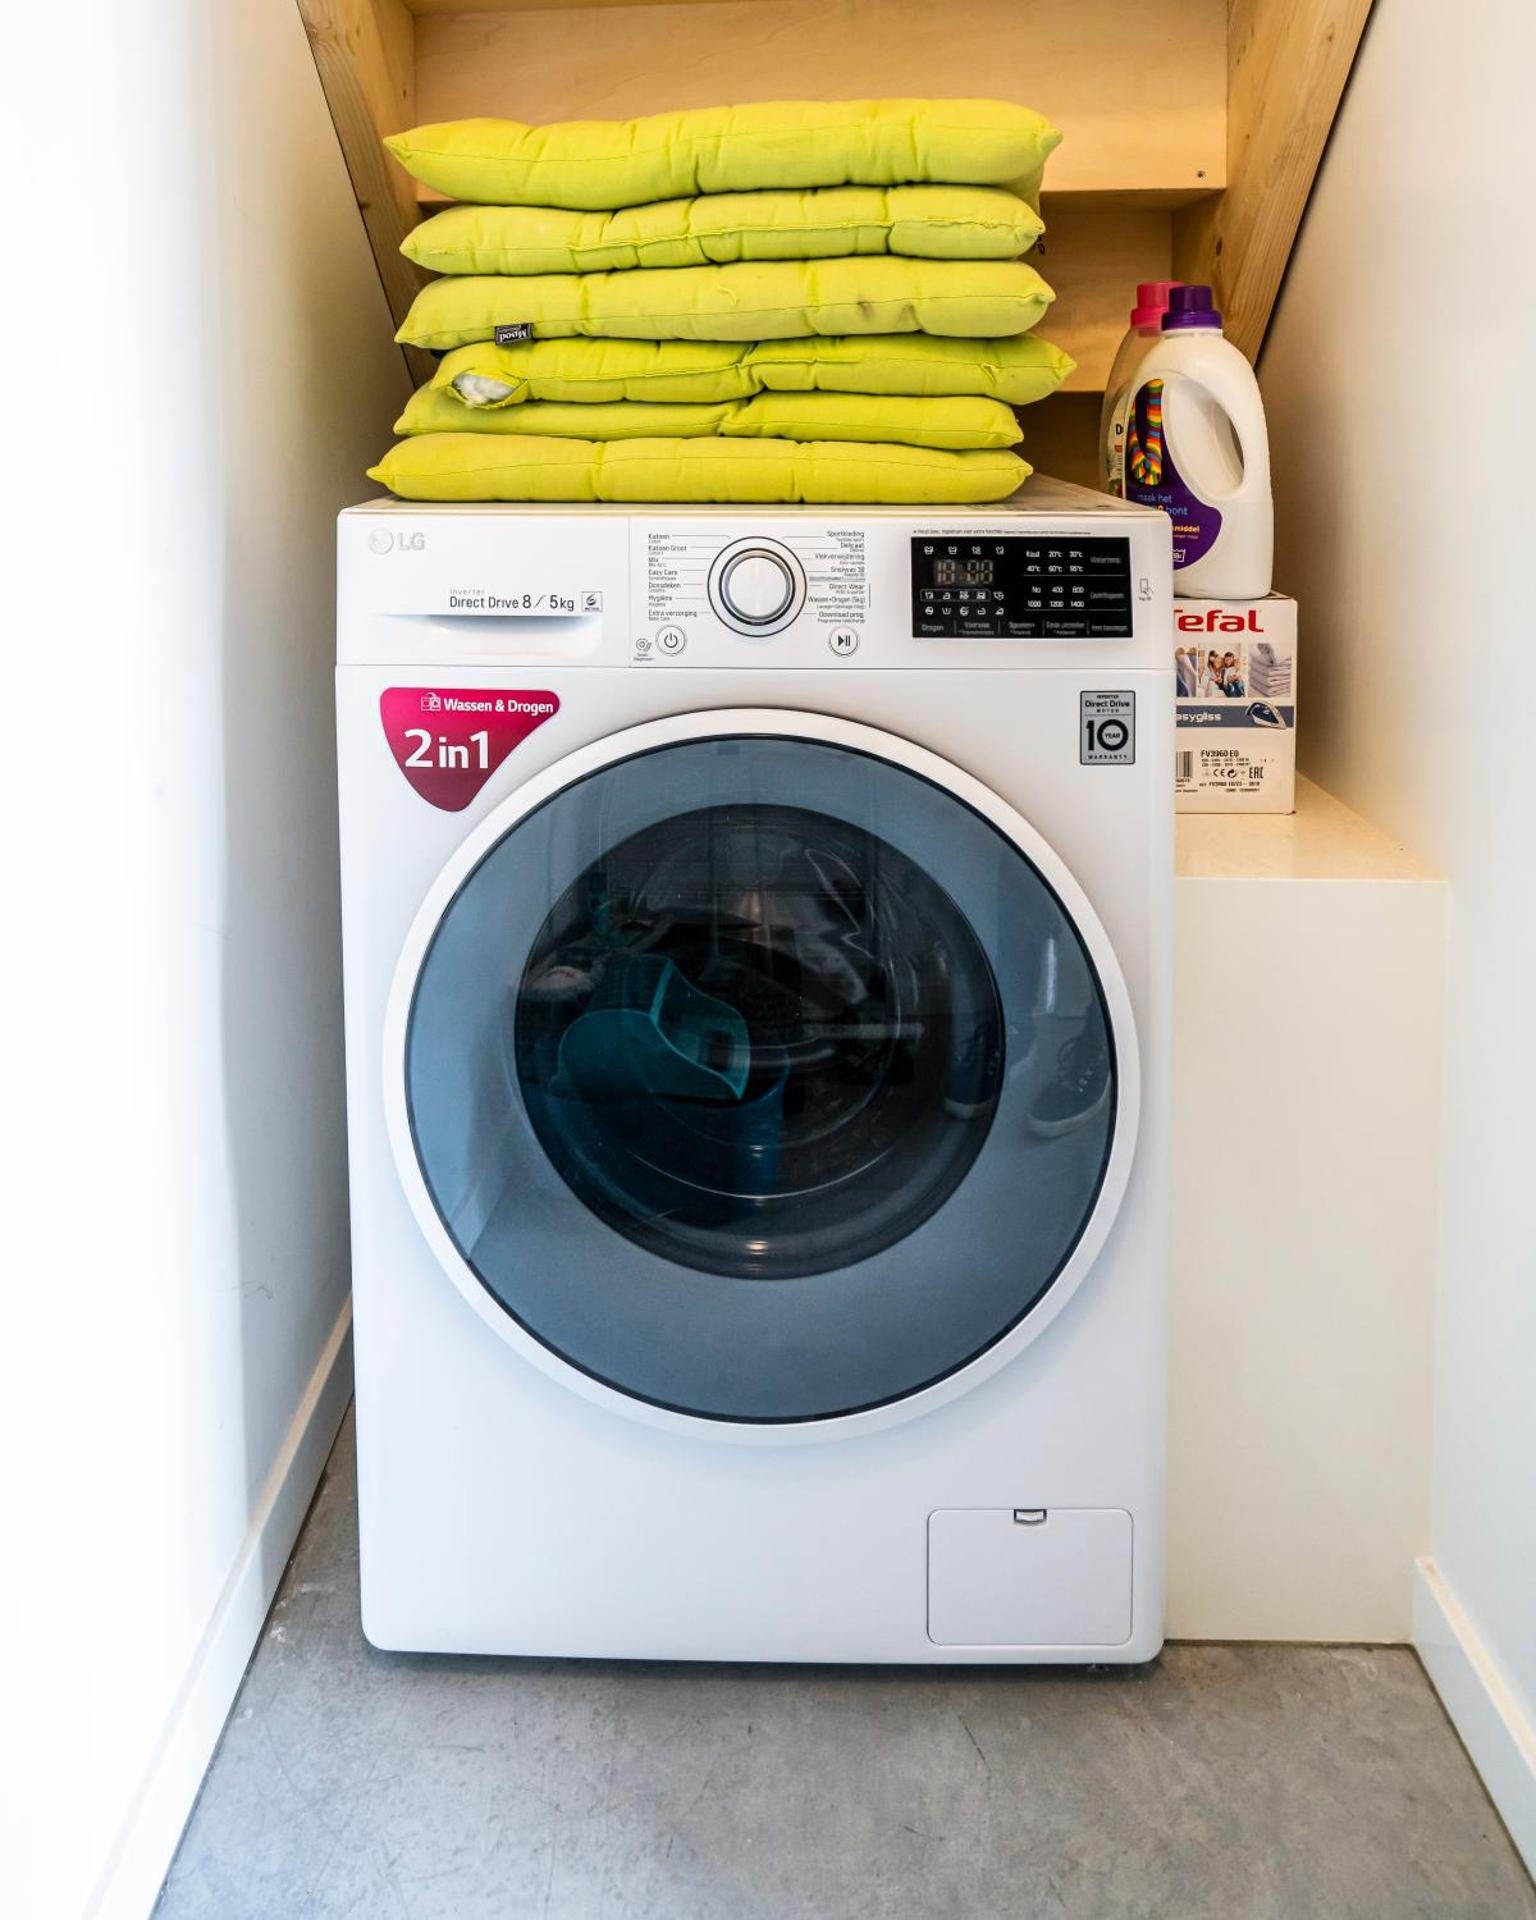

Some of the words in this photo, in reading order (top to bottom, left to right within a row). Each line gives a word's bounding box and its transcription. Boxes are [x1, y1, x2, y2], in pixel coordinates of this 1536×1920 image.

[499, 329, 527, 343] Mood
[1171, 525, 1200, 533] middel
[398, 531, 425, 551] LG
[449, 595, 485, 609] Direct
[488, 596, 519, 609] Drive
[522, 594, 532, 609] 8
[1173, 609, 1264, 633] efal
[443, 698, 492, 713] Wassen
[495, 699, 505, 713] &
[508, 699, 554, 717] Drogen
[1085, 700, 1108, 708] Direct
[1109, 700, 1130, 708] Drive
[1086, 718, 1129, 752] 10
